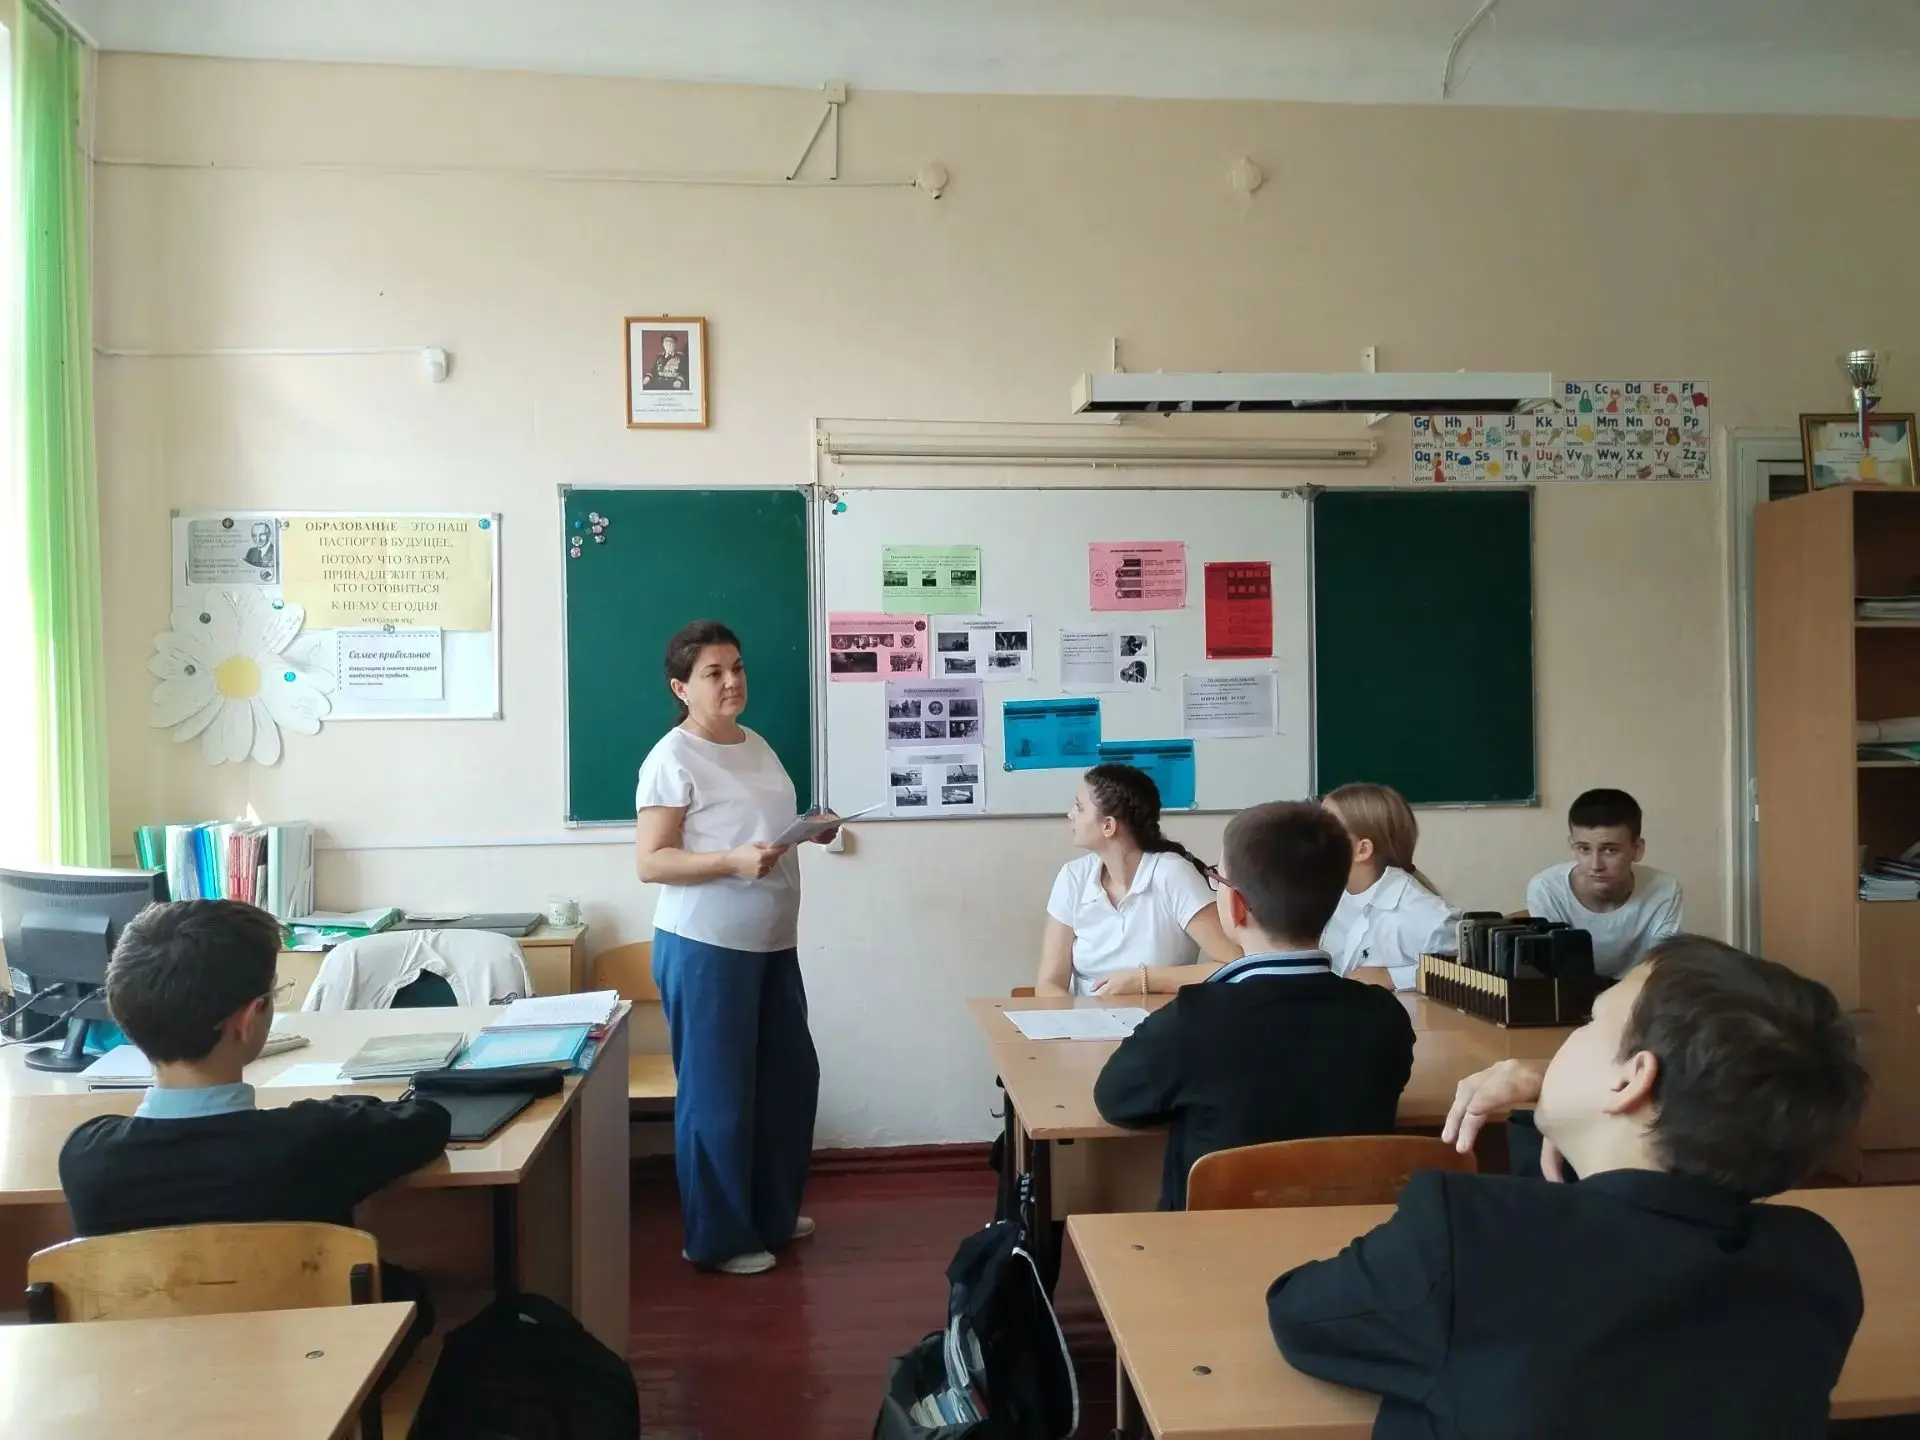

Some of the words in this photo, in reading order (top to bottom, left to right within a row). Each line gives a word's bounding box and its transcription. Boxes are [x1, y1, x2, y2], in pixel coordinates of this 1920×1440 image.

[1565, 383, 1581, 394] Bb
[1595, 383, 1608, 394] Cc
[1625, 383, 1641, 394] Dd
[1653, 383, 1669, 394] Ee
[1682, 383, 1694, 394] Ff
[1414, 417, 1430, 430] Gg
[1445, 416, 1462, 428] Hh
[1475, 416, 1483, 428] Ii
[1505, 417, 1516, 430] Jj
[1536, 416, 1553, 428] Kk
[1566, 416, 1578, 428] Ll
[1597, 416, 1618, 428] Mm
[1626, 416, 1643, 428] Nn
[1655, 416, 1671, 428] Oo
[1683, 416, 1699, 429] Pp
[1414, 450, 1431, 464] Qq
[1445, 450, 1459, 461] Rr
[1475, 449, 1490, 461] Ss
[1505, 450, 1518, 461] Tt
[1536, 450, 1553, 461] Uu
[1566, 450, 1582, 460] Vv
[1597, 449, 1620, 461] Ww
[1626, 449, 1644, 460] Xx
[1655, 449, 1670, 462] Yy
[1683, 449, 1697, 460] Zz
[305, 521, 398, 532] ОБРАЗОВАНИЕ
[411, 522, 435, 532] ЭТО
[438, 522, 468, 532] НАШ
[319, 537, 376, 547] ПАСПОРТ
[380, 537, 387, 547] В
[321, 554, 373, 564] ПОТОМУ
[378, 555, 402, 565] ЧТО
[405, 555, 451, 565] ЗАВТРА
[323, 570, 417, 580] ПРИНАДЛЕЖИТ
[333, 583, 357, 593] КТО
[361, 583, 440, 593] ГОТОВИТЬСЯ
[331, 601, 339, 610] К
[343, 601, 379, 611] НЕМУ
[348, 650, 377, 660] Самое
[379, 649, 432, 661] прибыльное
